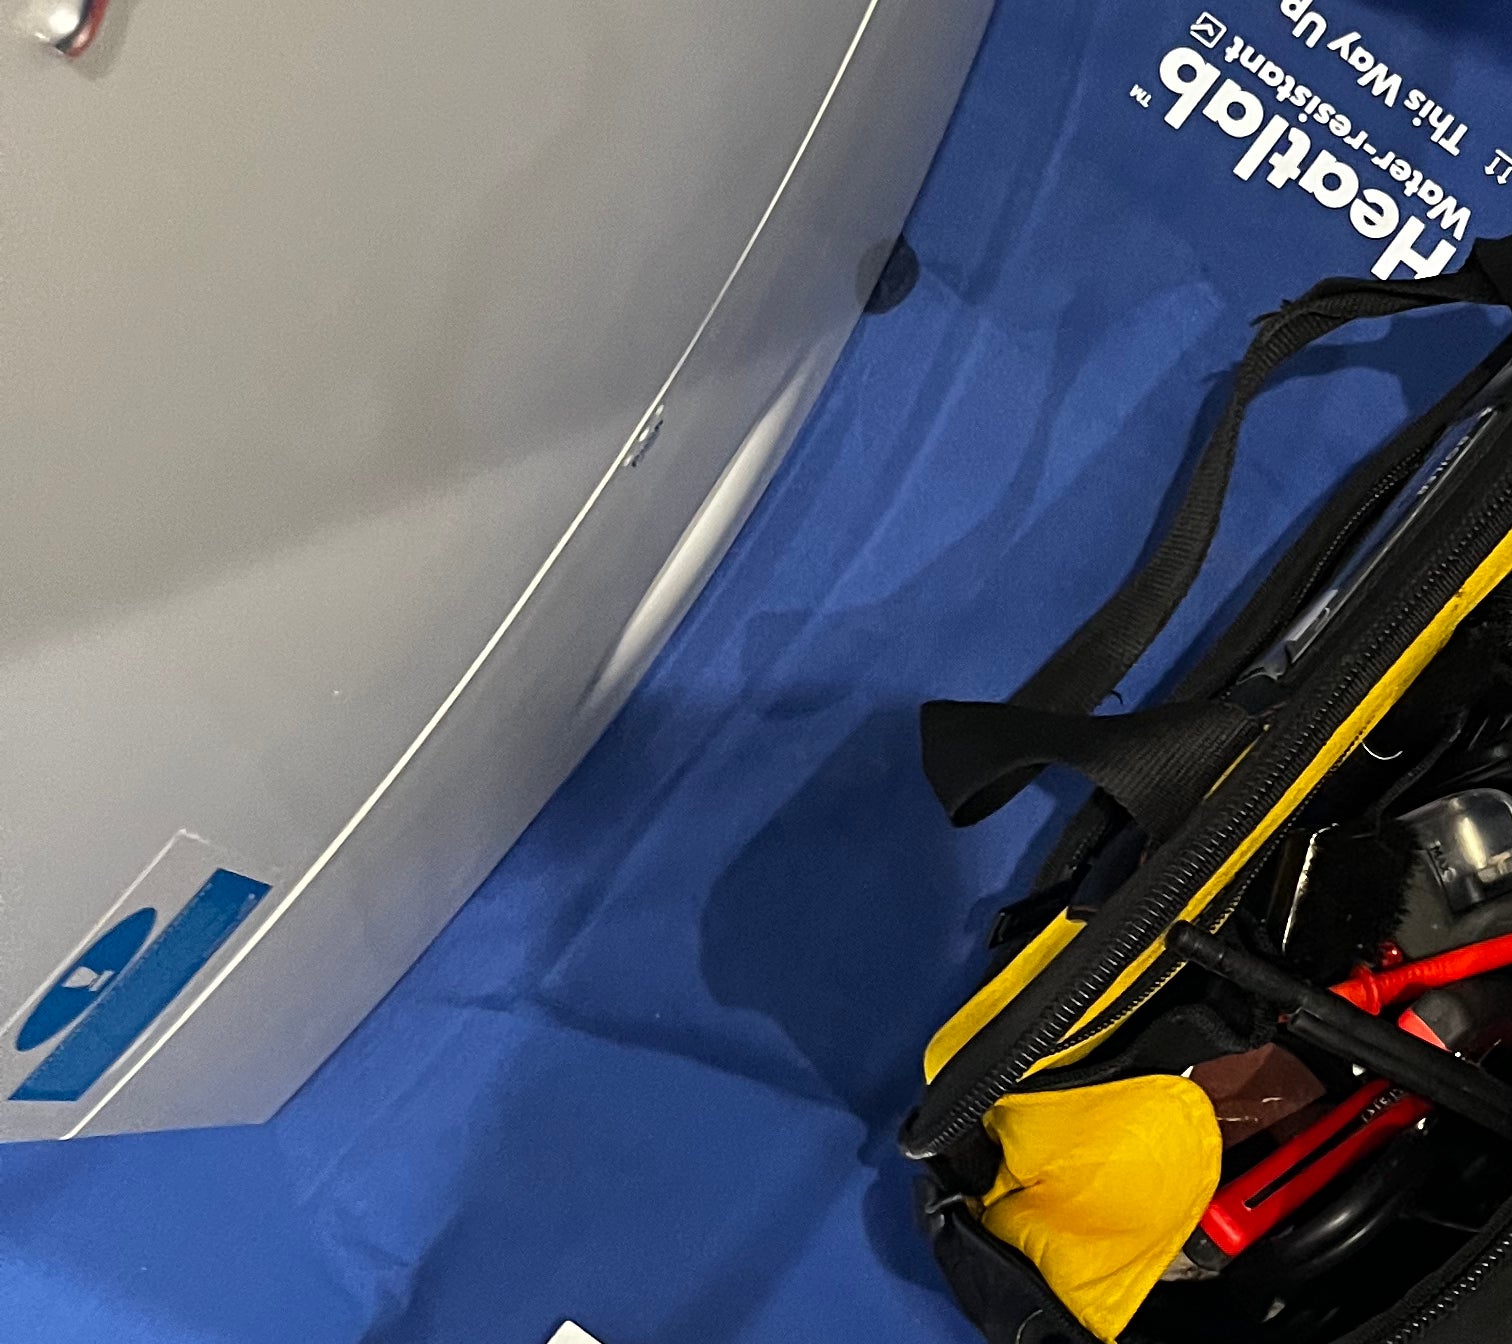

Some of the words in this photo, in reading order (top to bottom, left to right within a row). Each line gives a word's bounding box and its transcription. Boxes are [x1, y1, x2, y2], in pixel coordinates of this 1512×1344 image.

[1225, 35, 1472, 241] Water-resistant
[1327, 32, 1402, 108] Way
[1404, 93, 1469, 156] This
[1159, 46, 1457, 281] Heatlab
